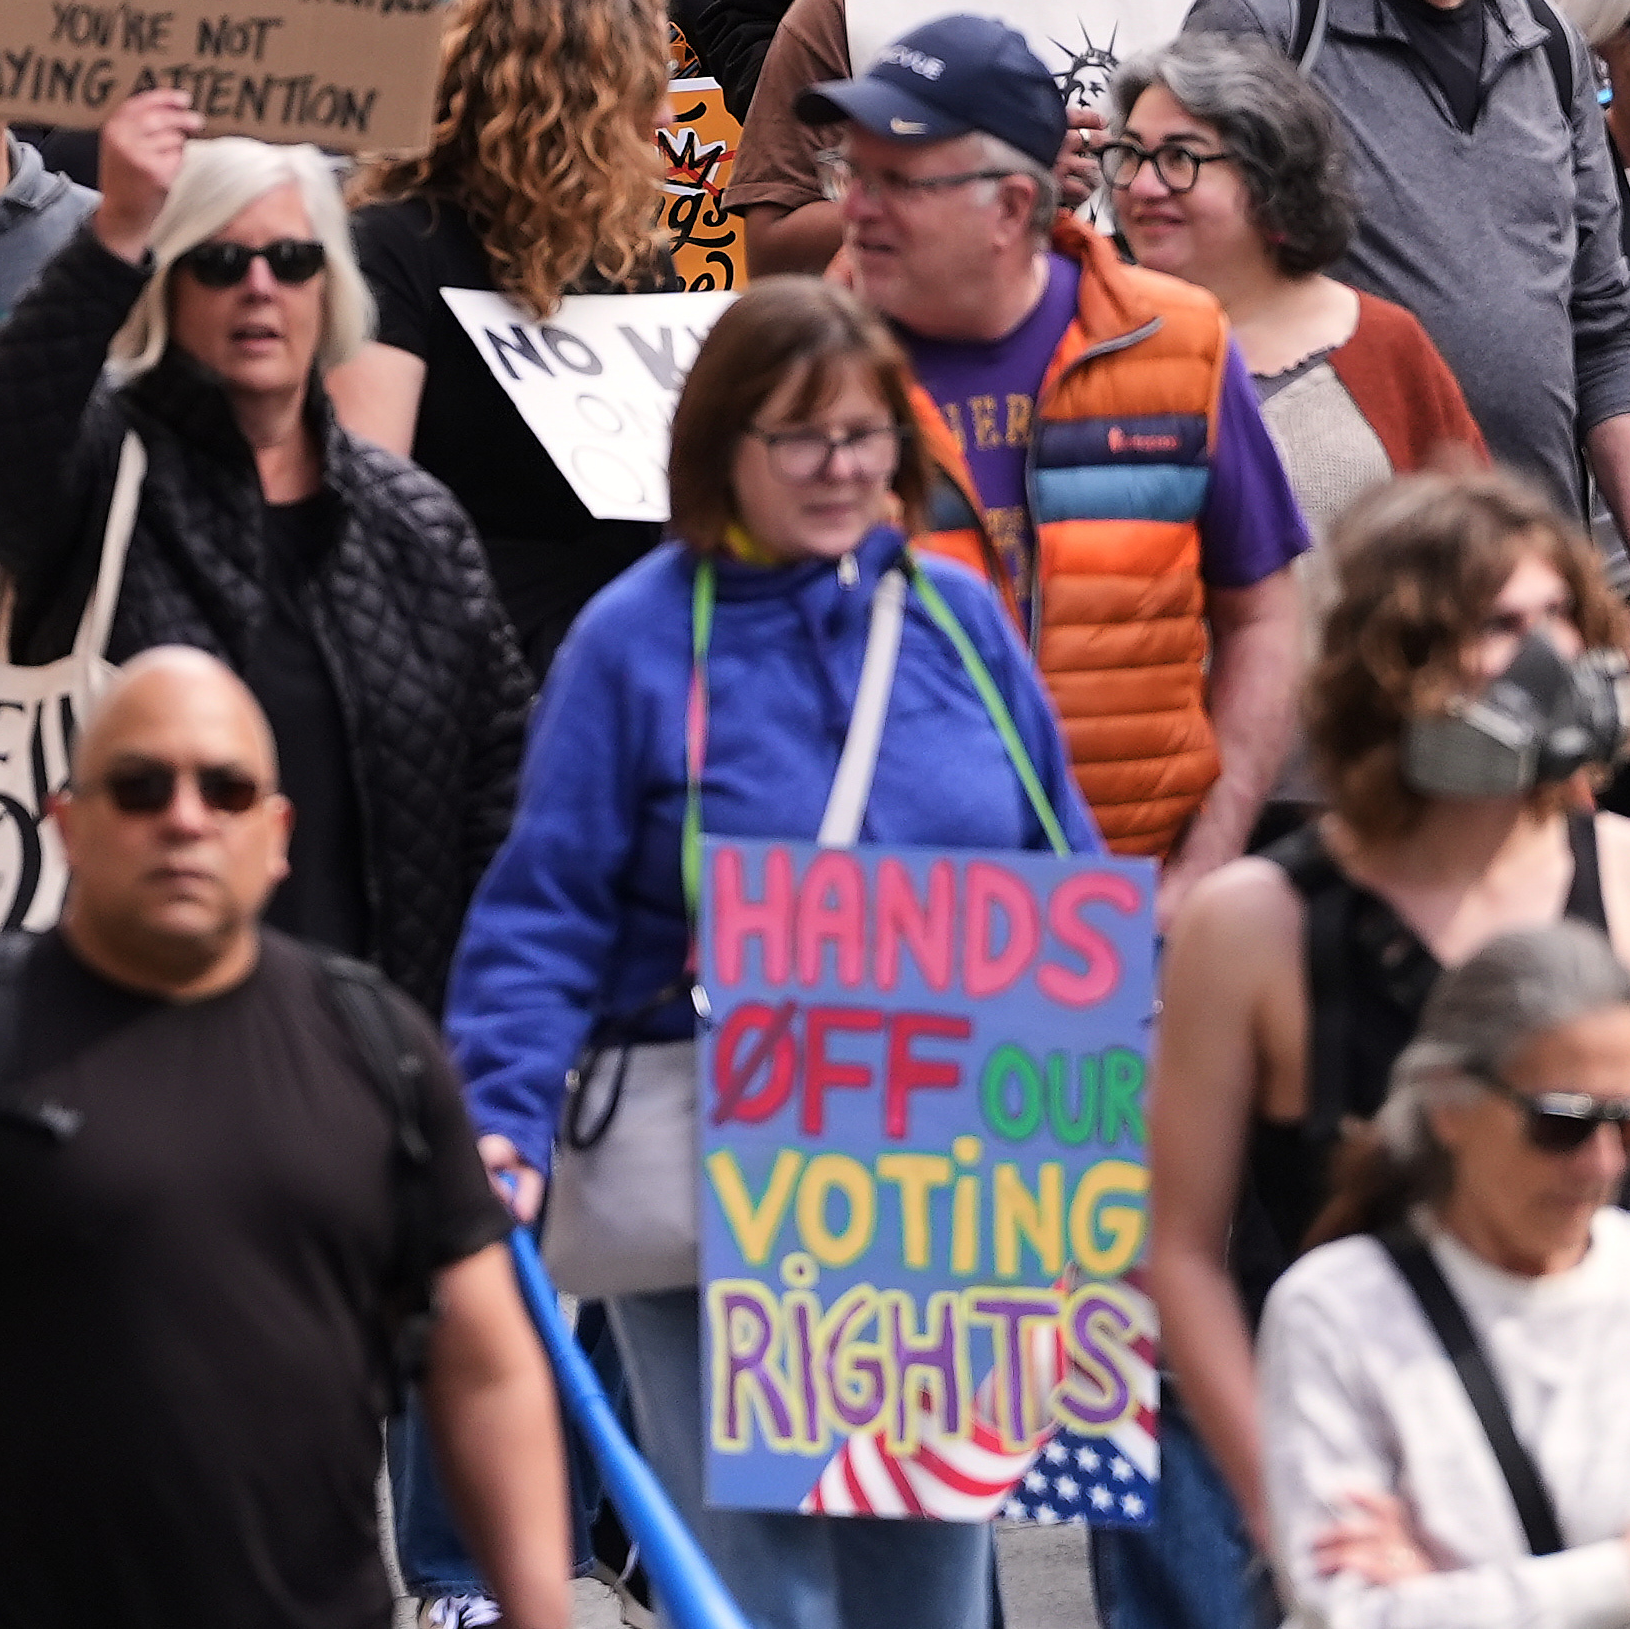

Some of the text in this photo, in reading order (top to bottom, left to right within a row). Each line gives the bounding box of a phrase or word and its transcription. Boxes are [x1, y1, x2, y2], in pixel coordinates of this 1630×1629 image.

[50, 0, 286, 64] YOU'RE NOT
[481, 322, 604, 381] NO
[710, 846, 1145, 1008] HANDS
[979, 1042, 1148, 1148] OUR
